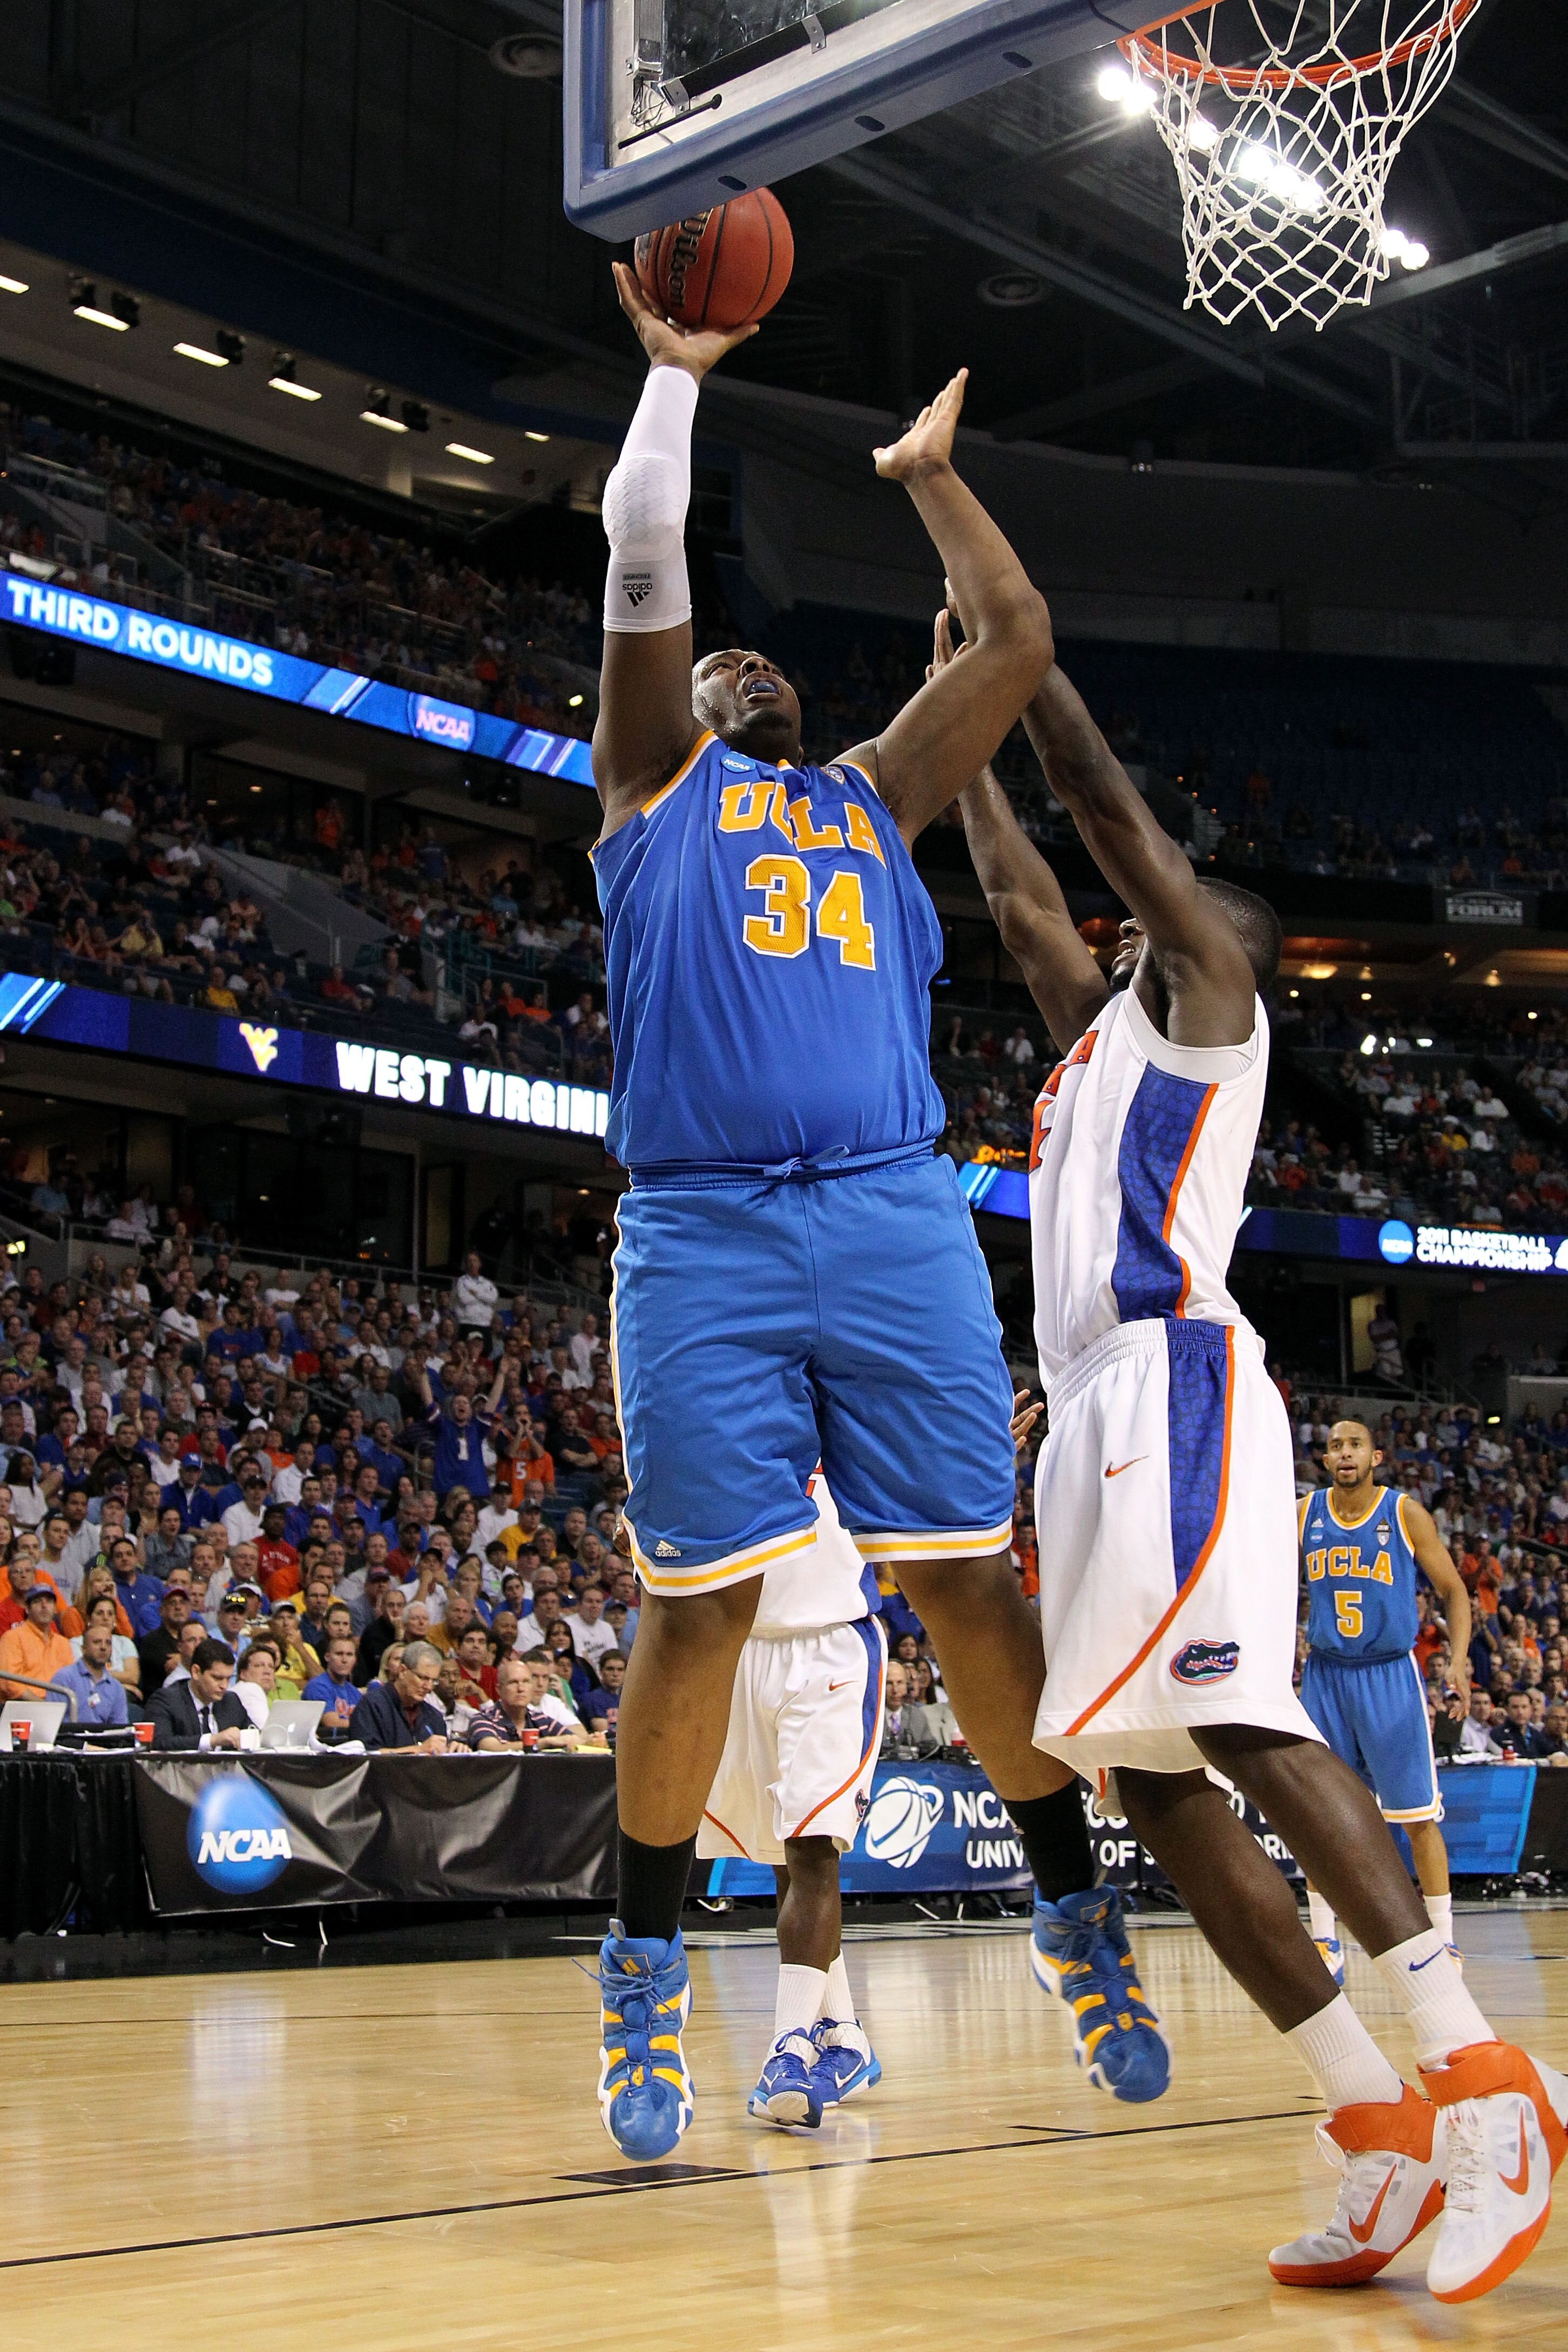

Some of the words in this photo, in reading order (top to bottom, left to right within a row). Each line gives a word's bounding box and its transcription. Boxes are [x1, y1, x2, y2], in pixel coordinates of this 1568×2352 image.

[622, 583, 652, 592] adidas
[8, 579, 119, 640] THIRD
[128, 616, 273, 686] ROUNDS
[416, 708, 469, 741] NCAA
[724, 759, 751, 771] NCAA
[718, 782, 887, 870] UCLA
[743, 854, 876, 971] 34
[336, 1042, 451, 1106] WEST
[1416, 1243, 1553, 1272] CHAMPIONSHIP
[1417, 1226, 1449, 1245] 2011
[1451, 1229, 1550, 1253] BASKETBALL
[1306, 1546, 1393, 1585] UCLA
[1334, 1590, 1363, 1638] 5
[198, 1828, 293, 1864] NCAA
[1099, 1839, 1137, 1867] OF
